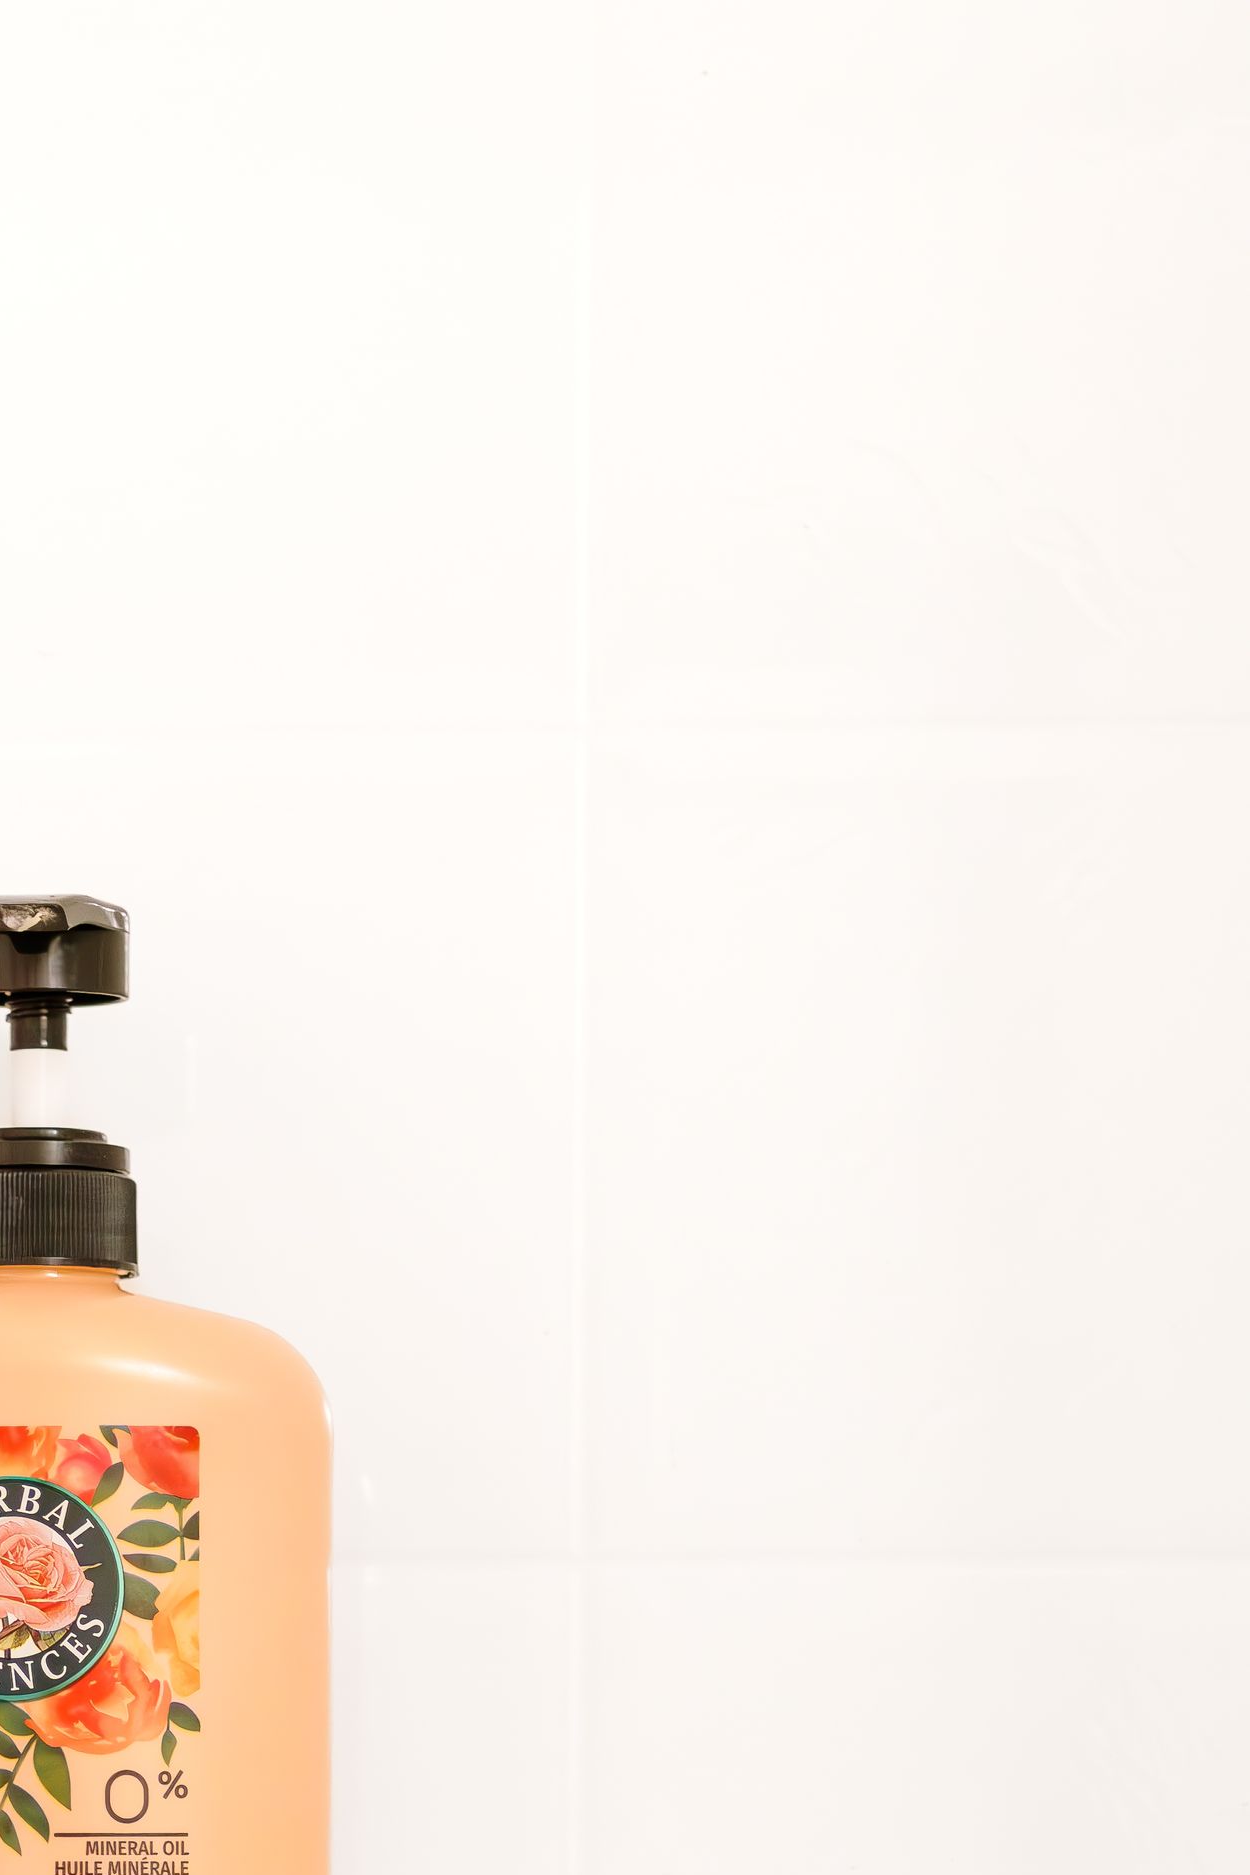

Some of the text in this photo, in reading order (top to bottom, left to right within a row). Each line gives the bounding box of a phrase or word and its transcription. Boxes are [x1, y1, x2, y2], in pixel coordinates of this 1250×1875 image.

[85, 1840, 190, 1856] MINERAL OIL
[54, 1857, 189, 1875] HUILE MINÉRALE
